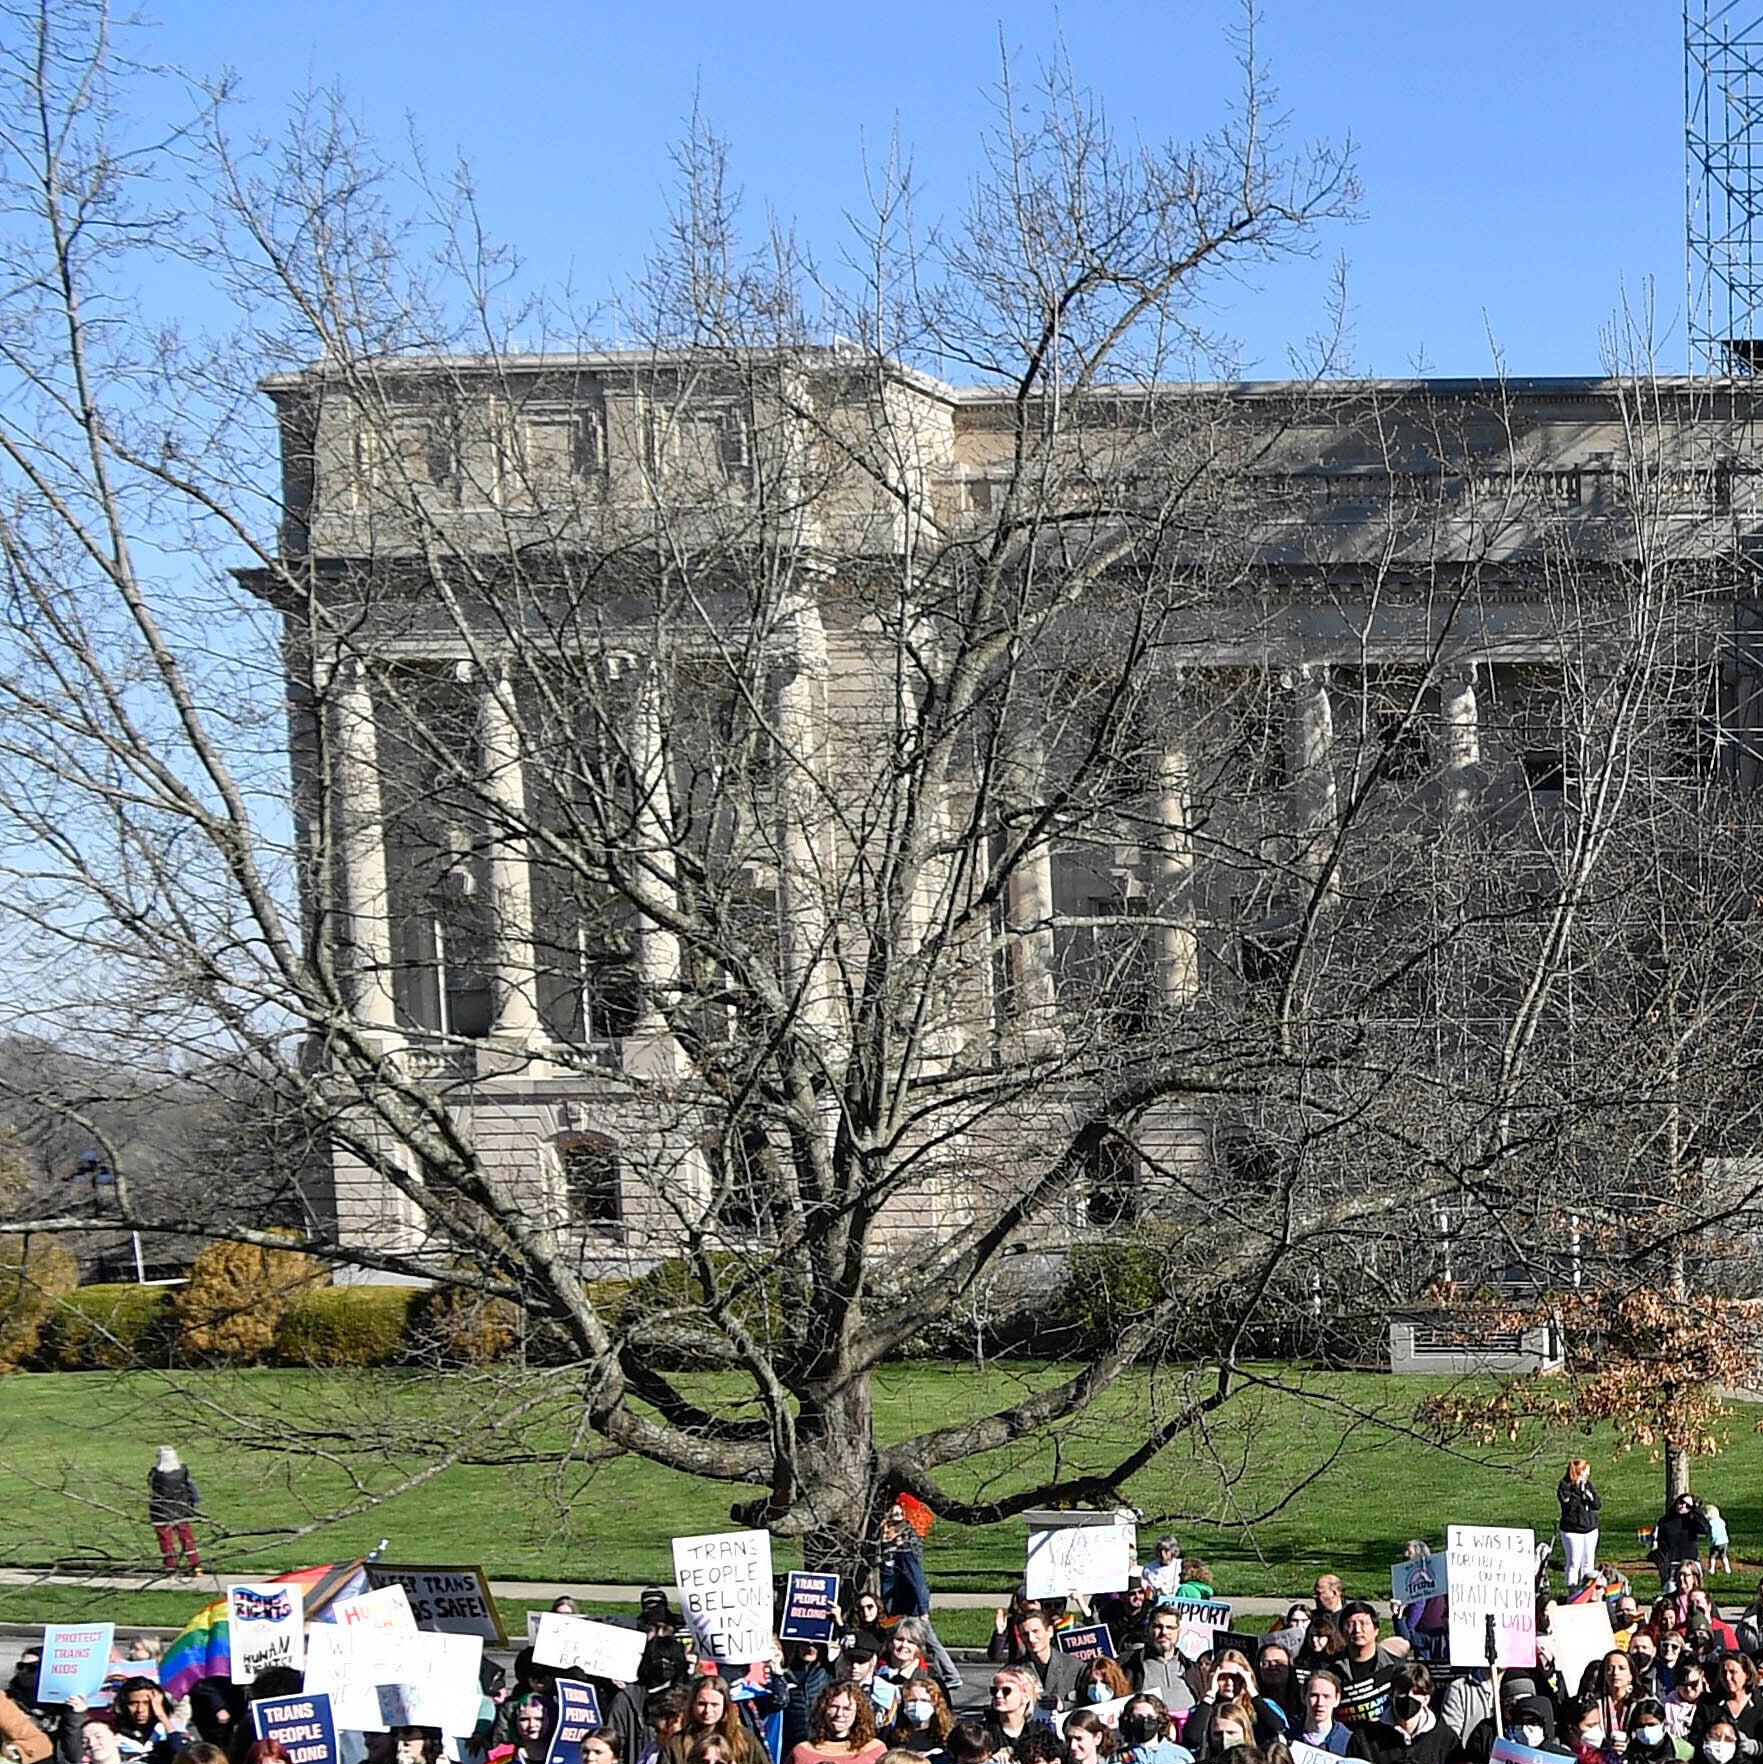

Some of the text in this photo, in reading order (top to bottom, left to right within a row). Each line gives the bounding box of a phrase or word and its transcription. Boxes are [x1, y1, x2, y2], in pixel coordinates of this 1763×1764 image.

[679, 1565, 758, 1588] PEOPLE
[422, 1575, 476, 1595] TRANS
[794, 1579, 825, 1592] TRANS
[792, 1594, 827, 1606] PEOPLE
[436, 1597, 488, 1620] SAFE!
[790, 1607, 827, 1619] BELONG
[54, 1631, 104, 1643] PROTECT
[1064, 1632, 1096, 1647] TRANS
[53, 1647, 91, 1659] TRANS
[264, 1703, 315, 1723] TRANS
[268, 1723, 323, 1743] PEOPLE
